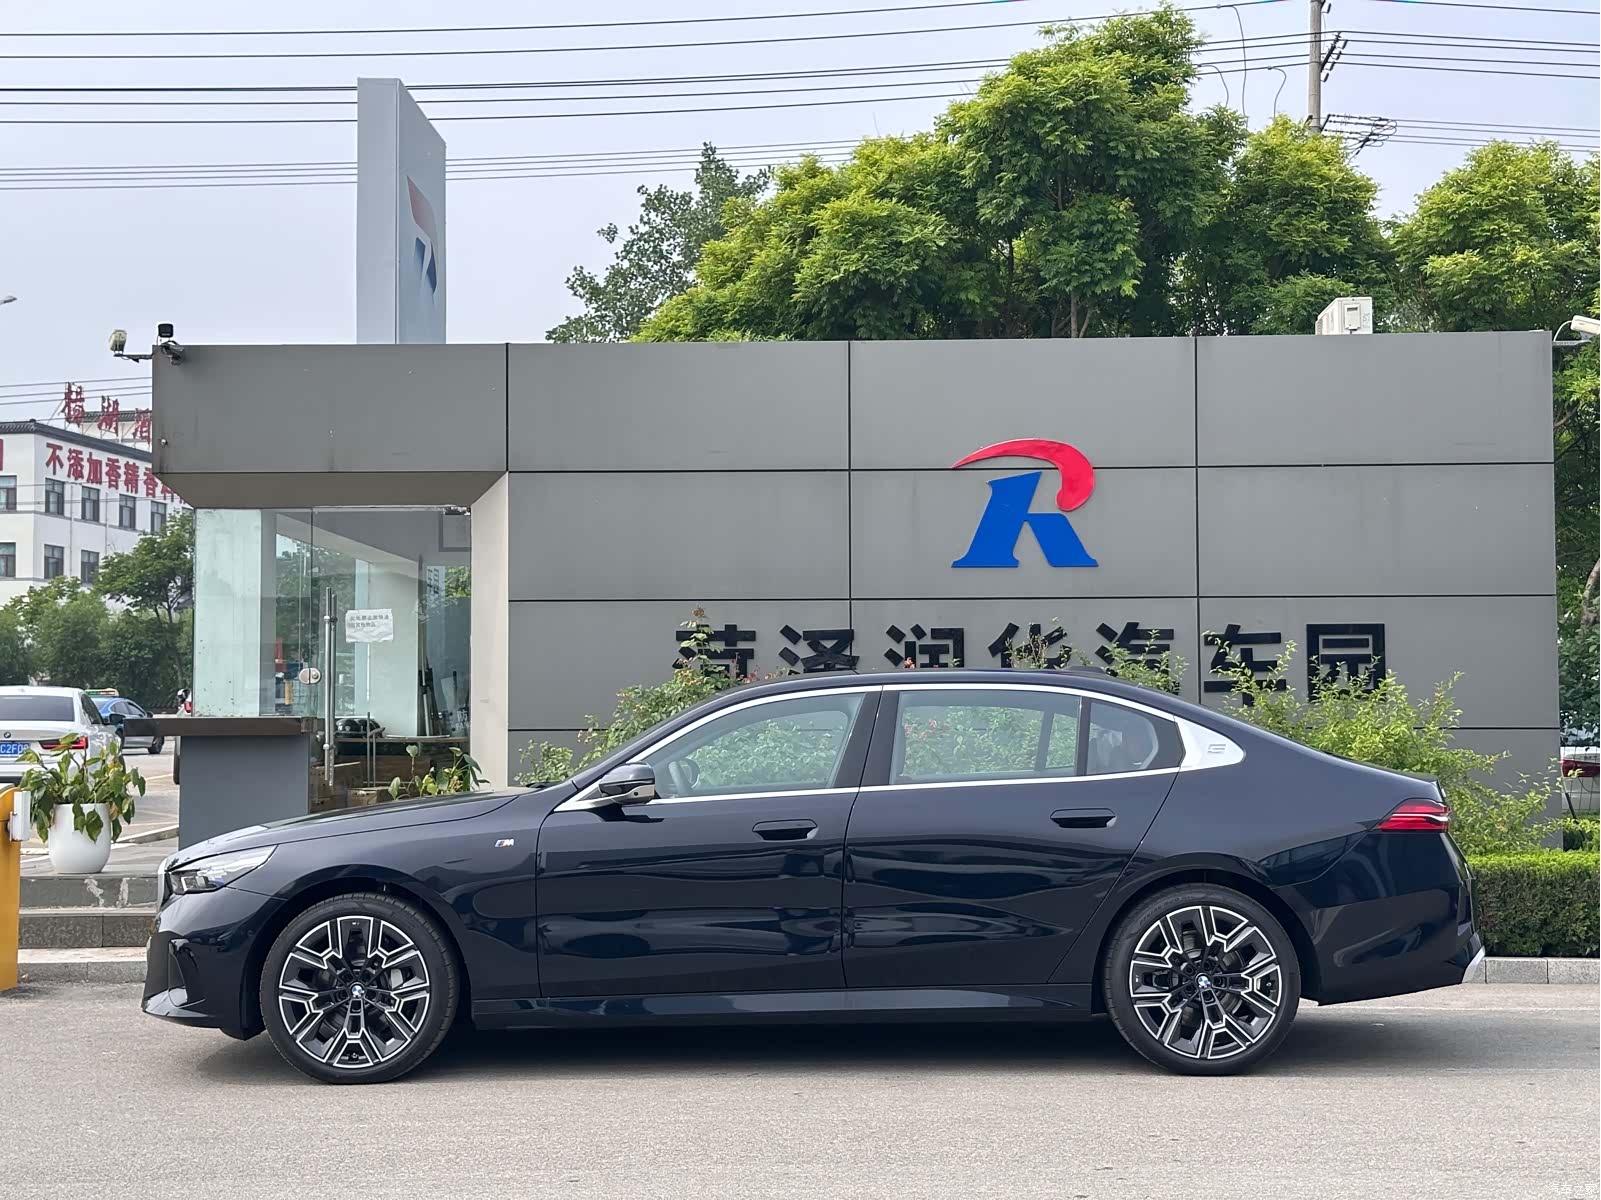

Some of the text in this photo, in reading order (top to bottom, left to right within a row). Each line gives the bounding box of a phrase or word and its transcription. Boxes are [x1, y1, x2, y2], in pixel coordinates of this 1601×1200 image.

[46, 442, 187, 504] 不添加香精香
